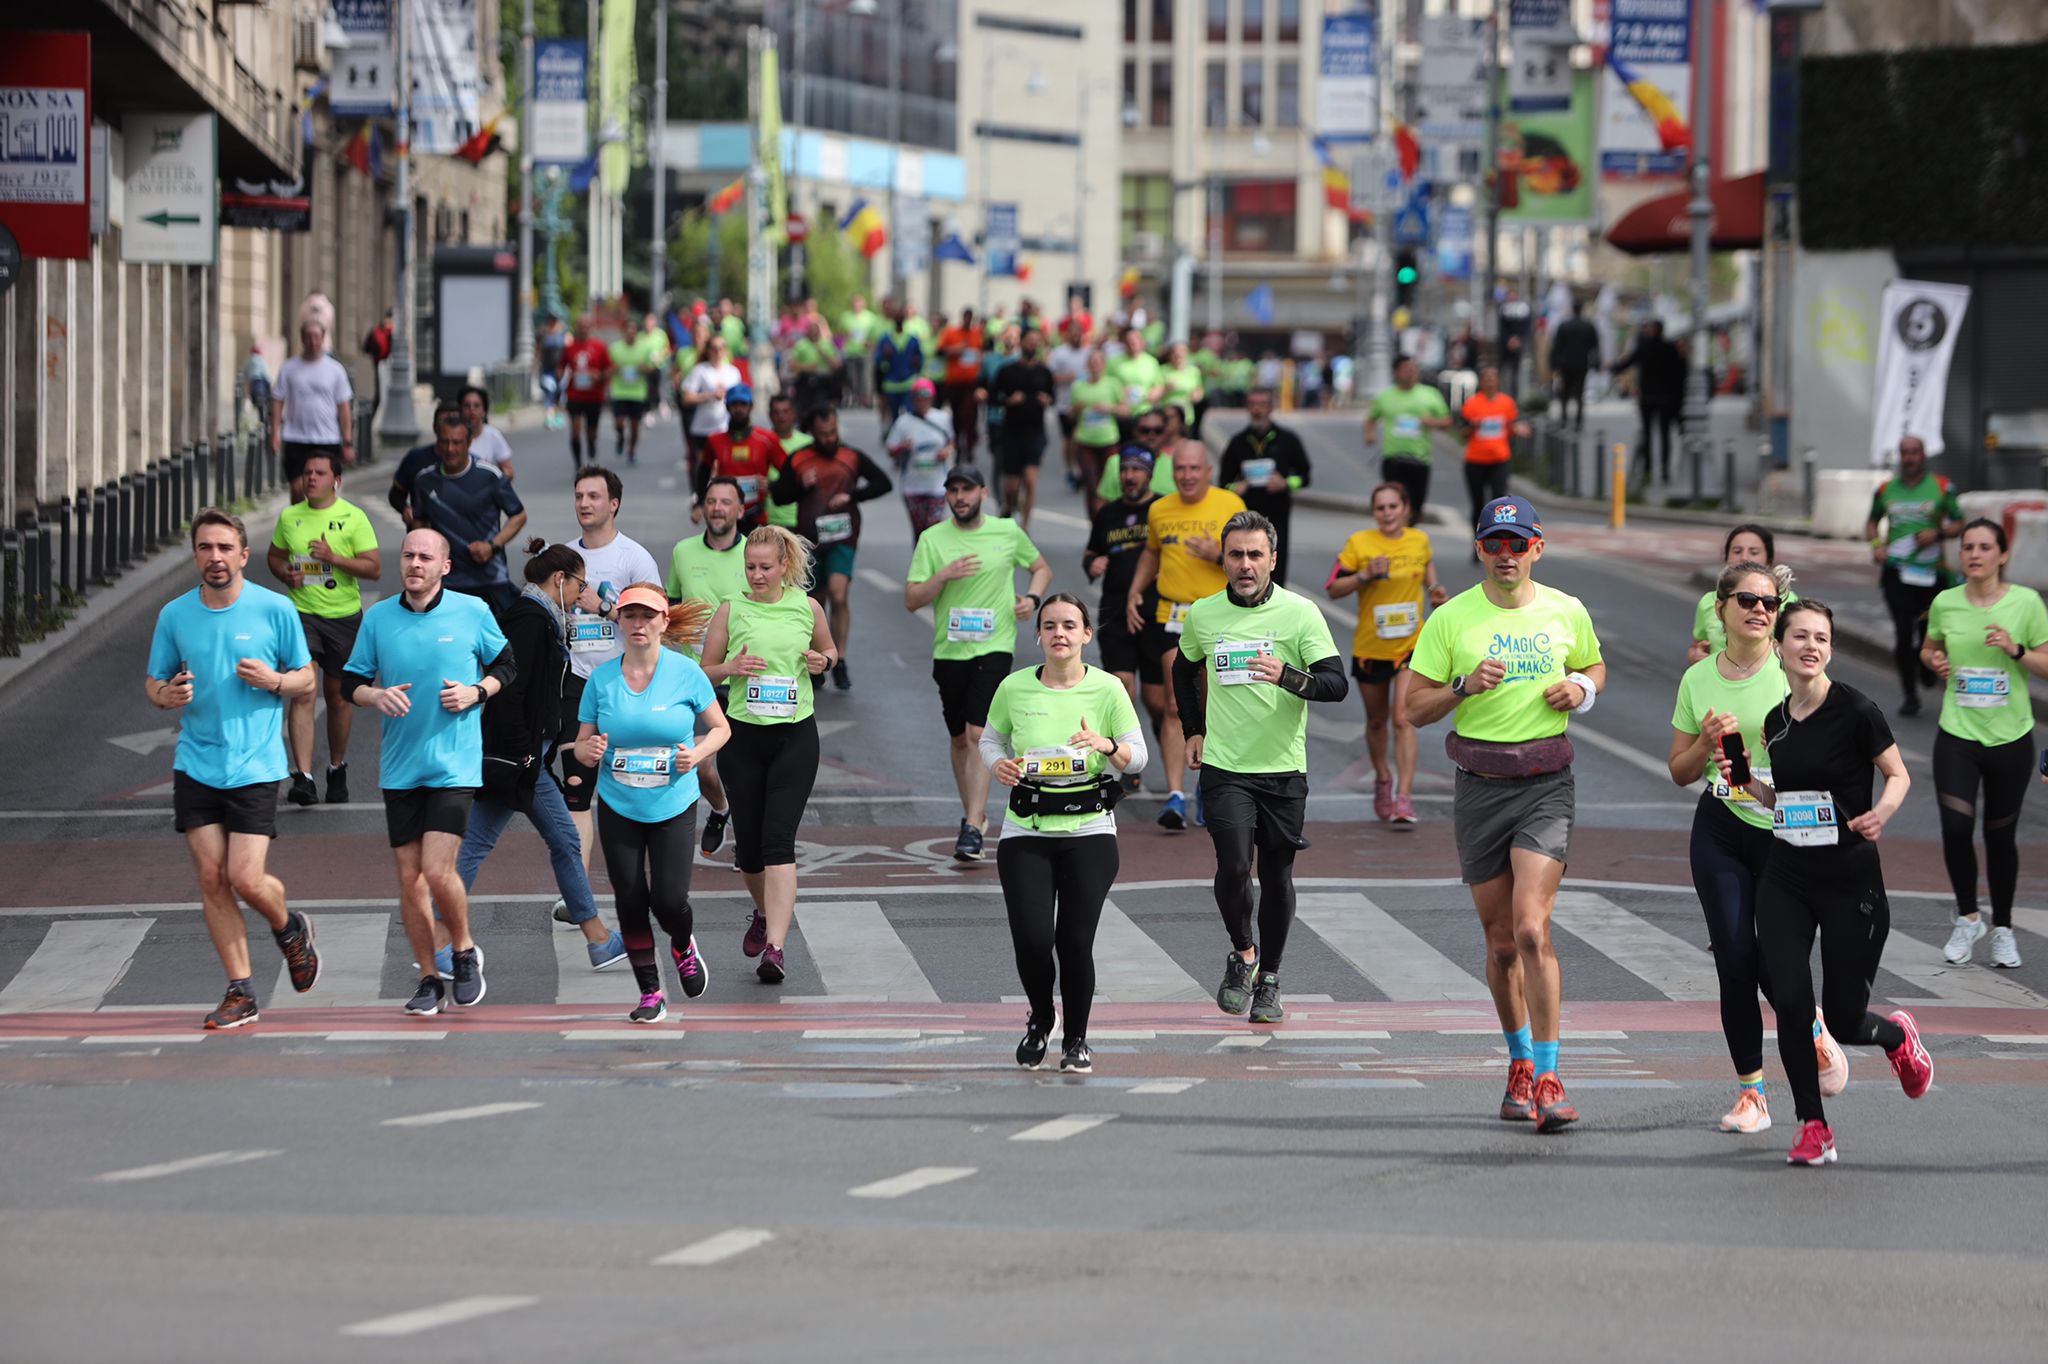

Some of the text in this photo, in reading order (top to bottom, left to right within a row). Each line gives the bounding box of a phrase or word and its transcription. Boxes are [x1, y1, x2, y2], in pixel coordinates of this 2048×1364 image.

[46, 91, 73, 108] SA
[328, 521, 344, 530] EY
[1489, 633, 1551, 655] MAGIC
[1517, 655, 1552, 674] MAKE
[762, 689, 785, 698] 10127
[1045, 760, 1066, 771] 291
[1787, 810, 1813, 821] 12098
